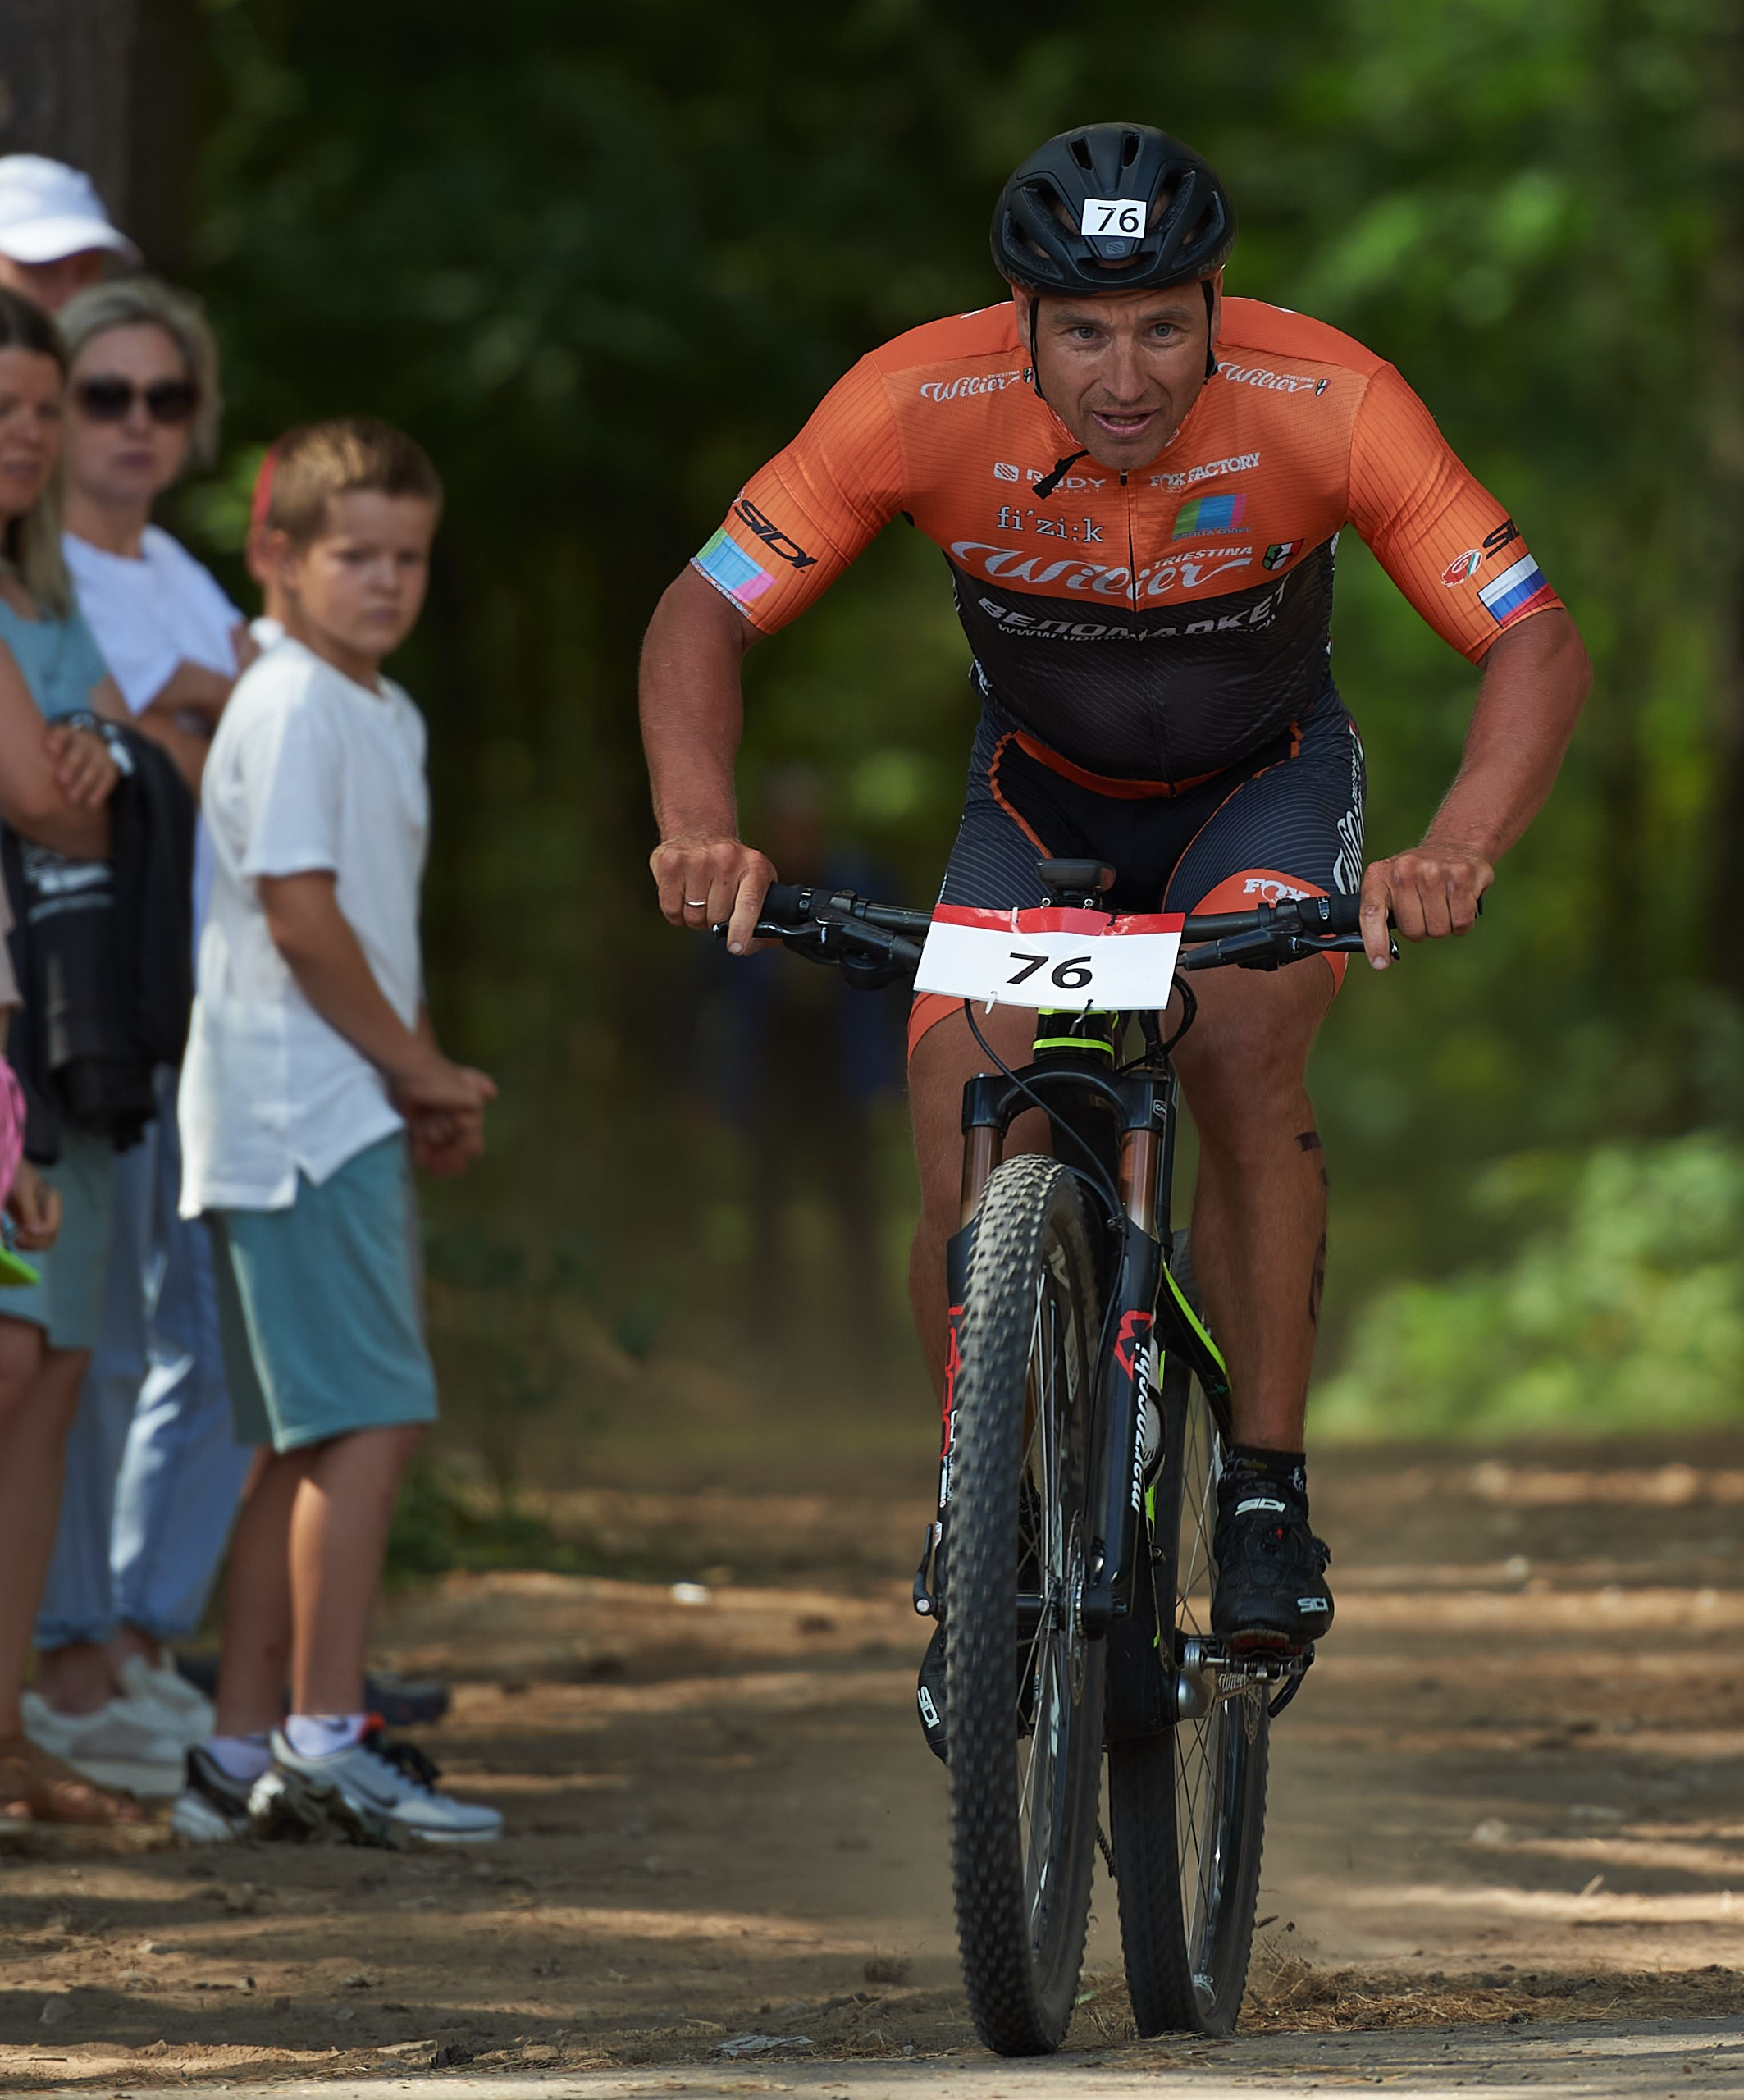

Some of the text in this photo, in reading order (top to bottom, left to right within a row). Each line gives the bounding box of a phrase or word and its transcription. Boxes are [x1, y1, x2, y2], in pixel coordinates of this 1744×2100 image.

[1097, 206, 1139, 233] 76
[920, 375, 1020, 403] Wilier
[1217, 361, 1314, 393] Wilier
[1149, 452, 1261, 491] FOX FACTORY
[950, 541, 1253, 602] Wilier
[1153, 546, 1253, 569] TRIESTINA
[1005, 952, 1093, 989] 76
[1235, 1497, 1286, 1517] SIDI
